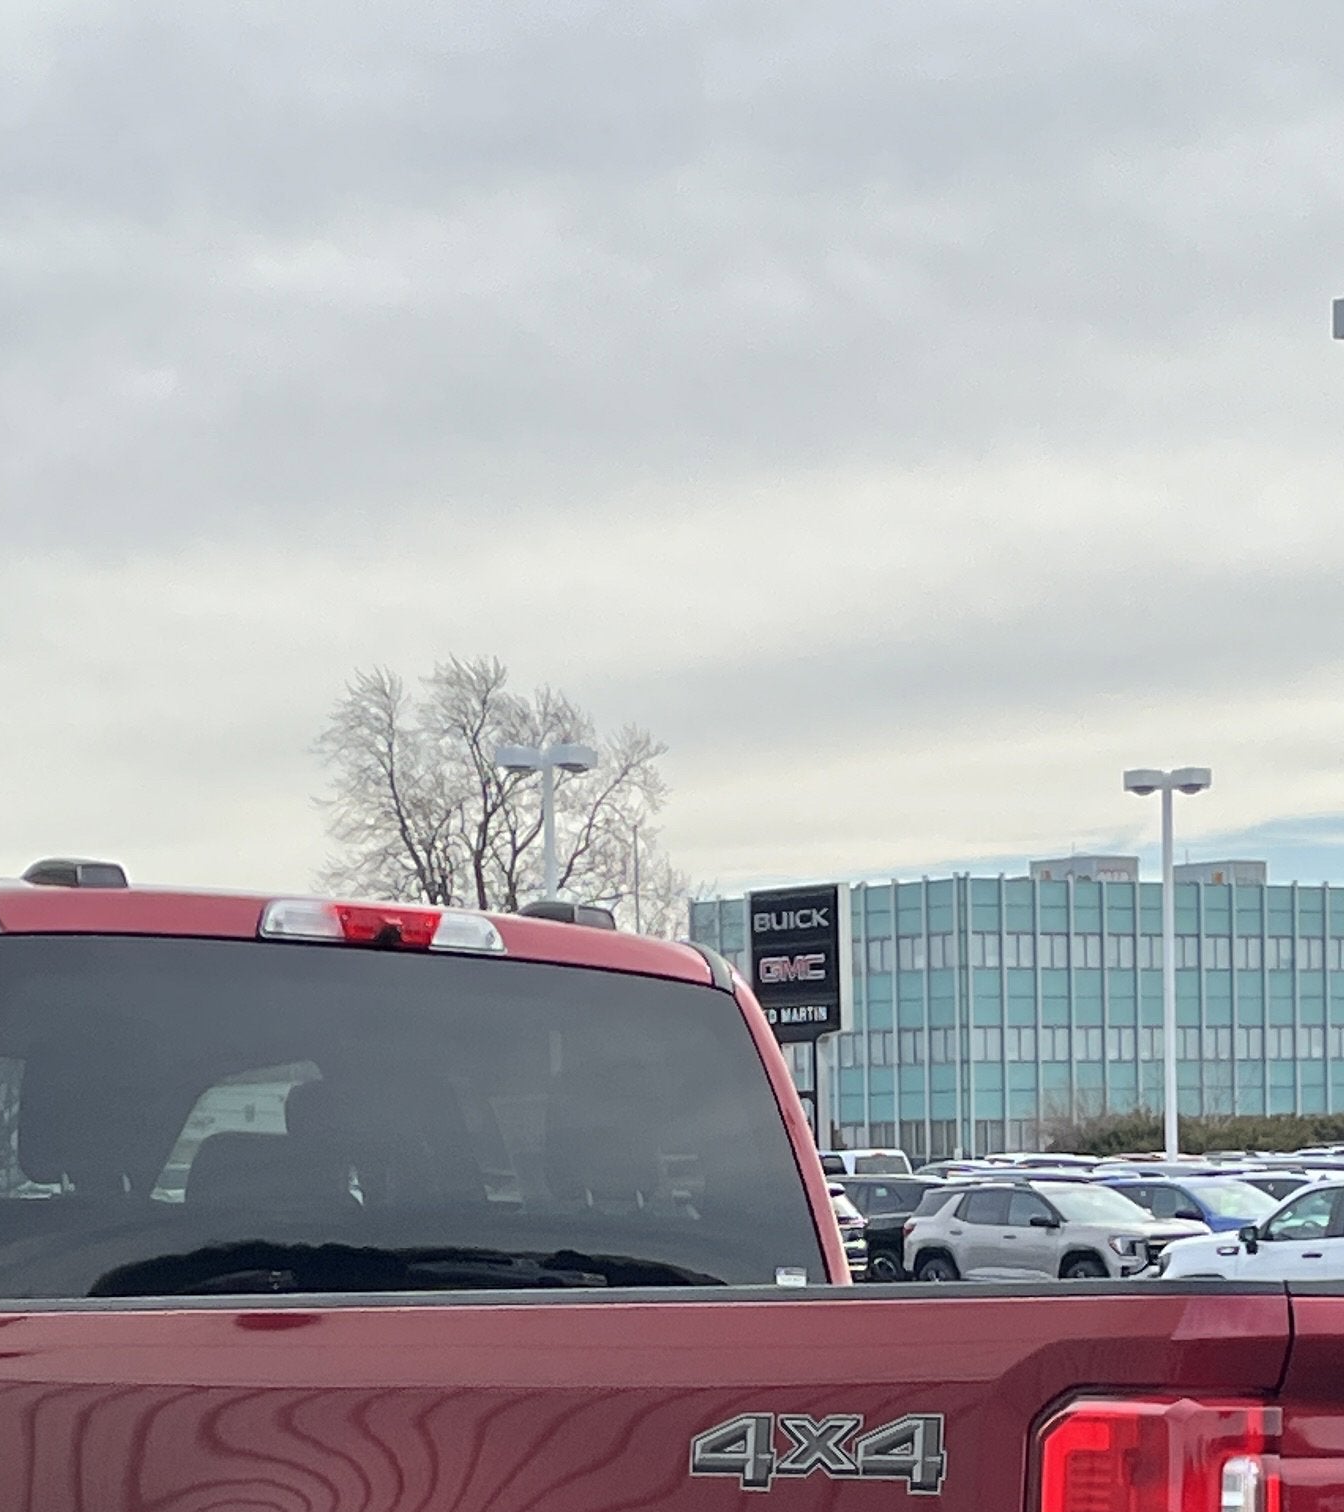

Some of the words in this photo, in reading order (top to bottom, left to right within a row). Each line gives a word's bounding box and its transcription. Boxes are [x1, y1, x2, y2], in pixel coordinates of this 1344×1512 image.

[753, 907, 829, 932] BUICK
[759, 953, 826, 983] GMC
[780, 1006, 828, 1024] MARTIN
